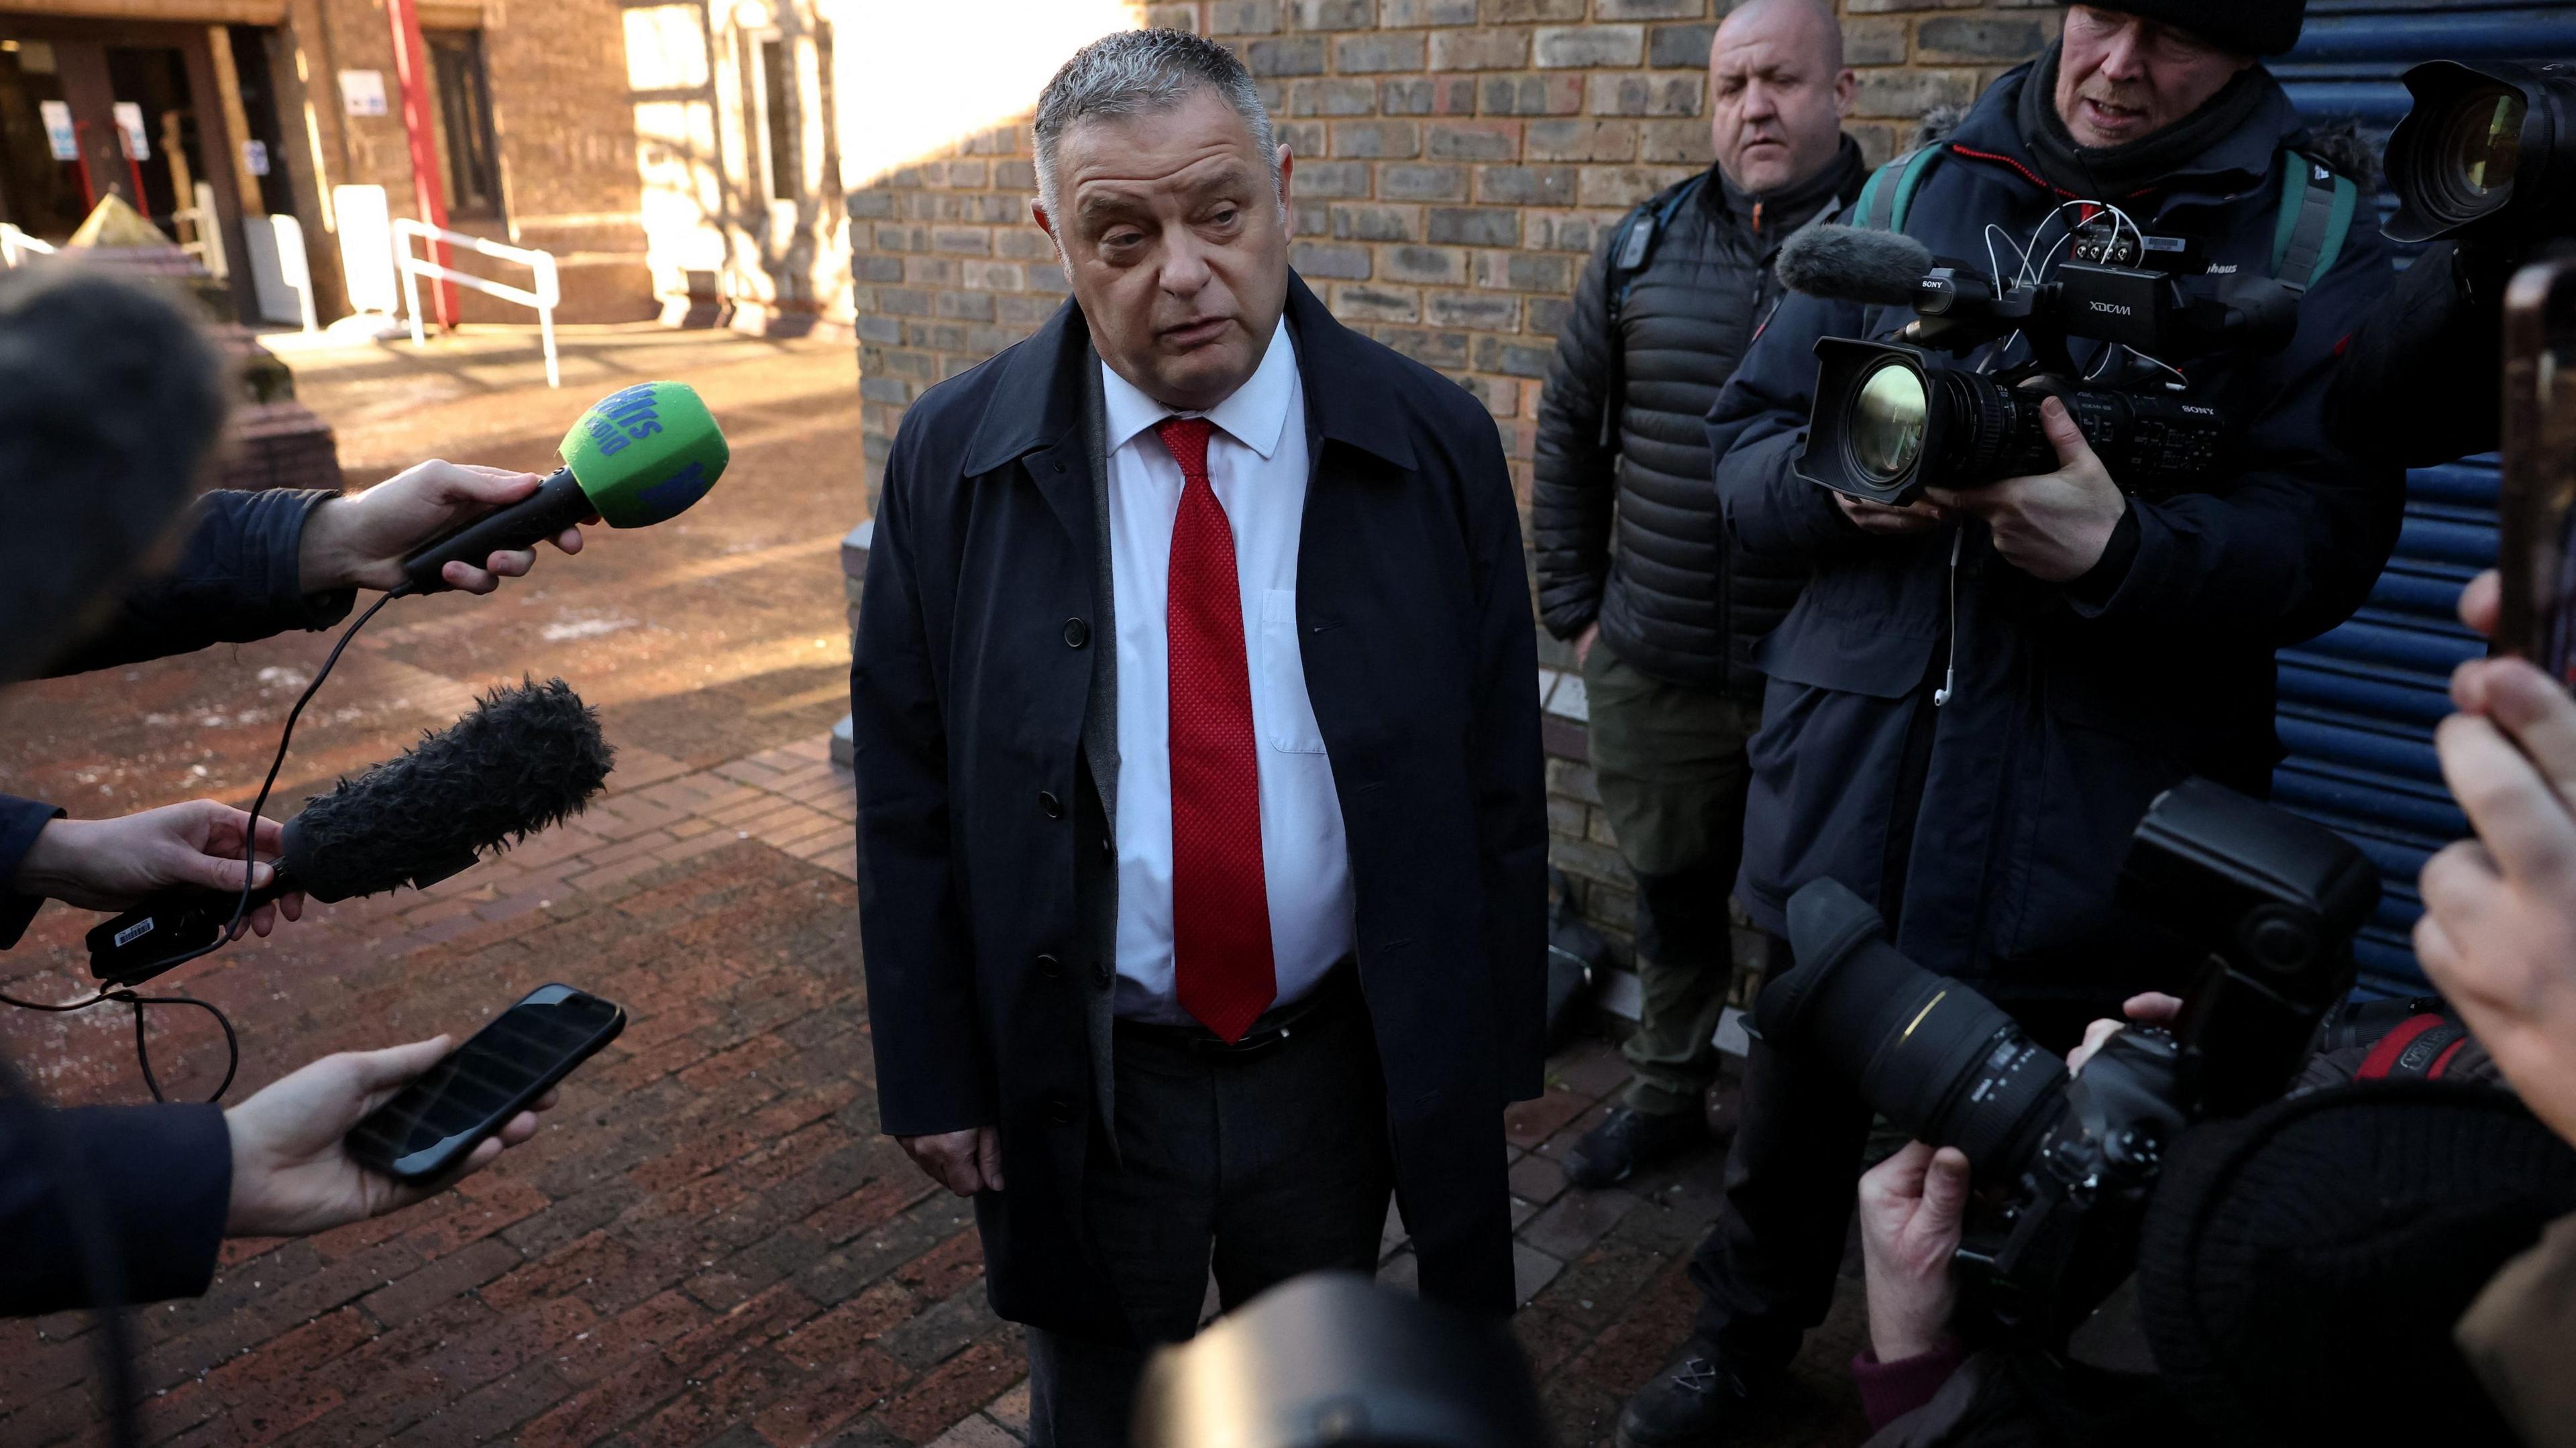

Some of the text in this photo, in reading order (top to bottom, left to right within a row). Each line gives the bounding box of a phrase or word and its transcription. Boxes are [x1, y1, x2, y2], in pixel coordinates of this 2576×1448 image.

[1922, 280, 1943, 288] SONY
[2090, 301, 2131, 316] XDCAM
[2182, 405, 2214, 416] SONY
